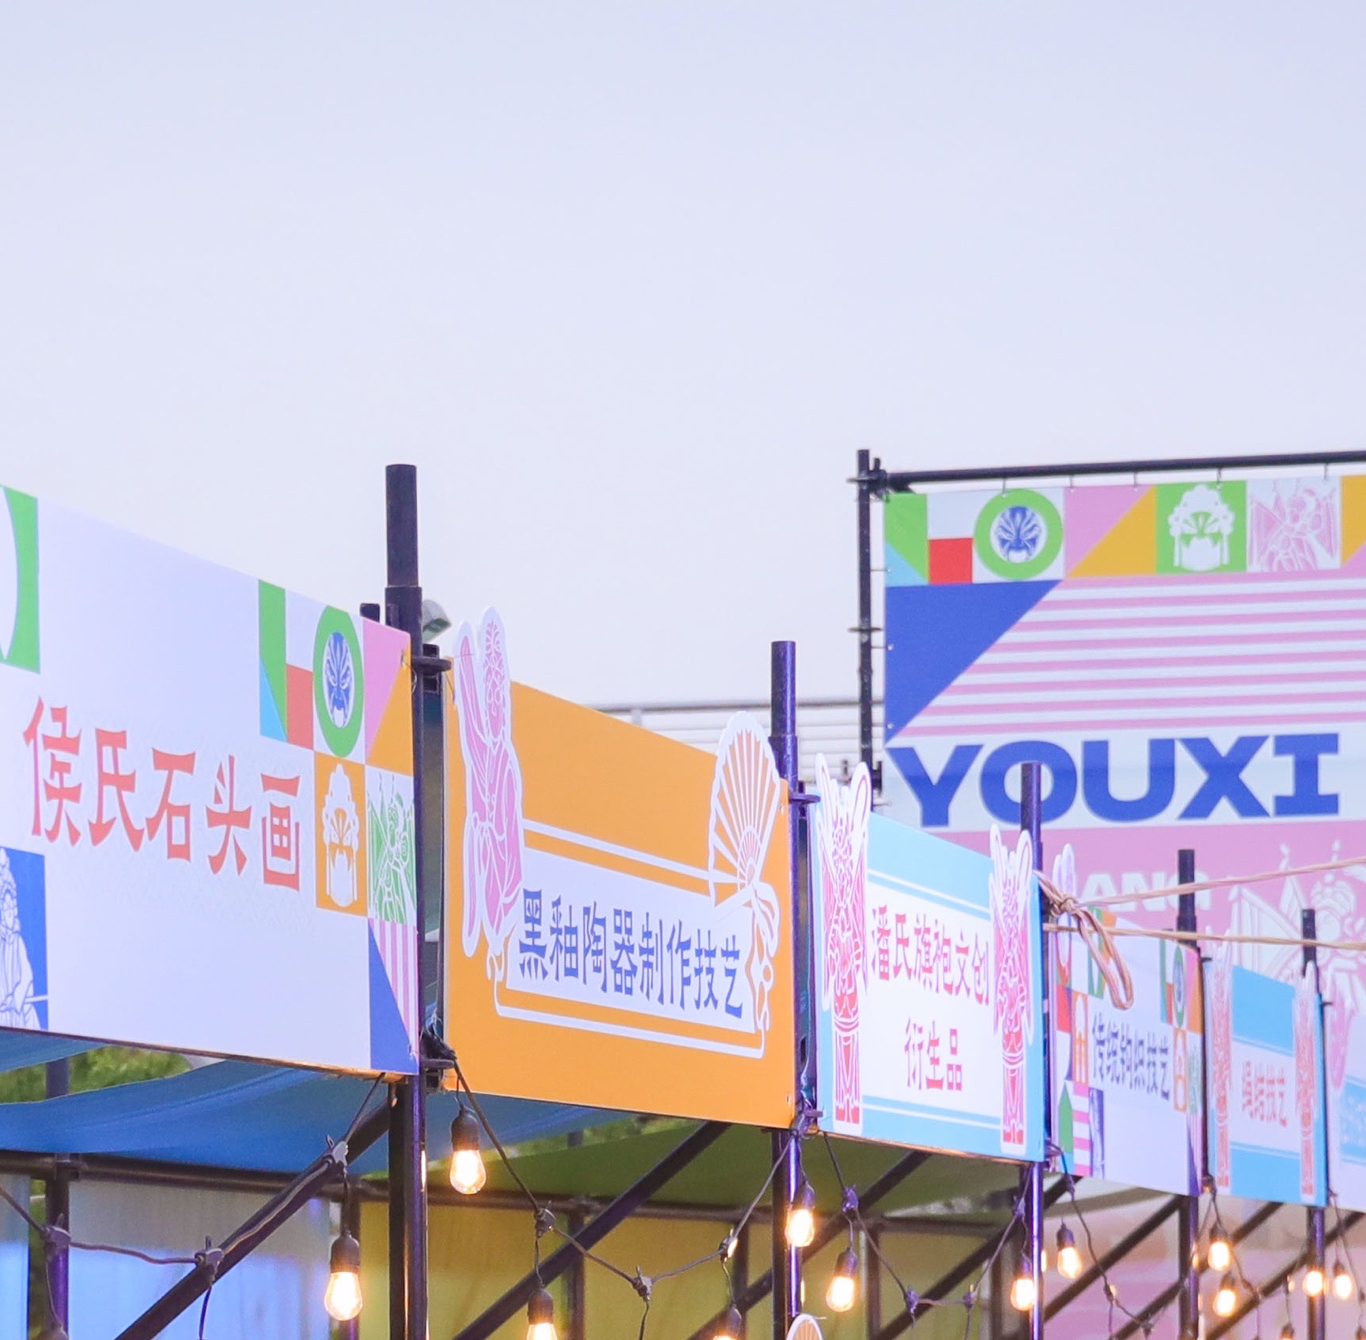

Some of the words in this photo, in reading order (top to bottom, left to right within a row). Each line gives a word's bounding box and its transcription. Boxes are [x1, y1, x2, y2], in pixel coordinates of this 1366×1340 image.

[22, 694, 304, 893] 侯氏石头画
[884, 731, 1341, 829] YOUXI
[518, 887, 744, 1020] 黑釉陶器制作技艺
[871, 904, 990, 1006] 潘氏旗袍文创
[904, 1015, 963, 1091] 衍生品
